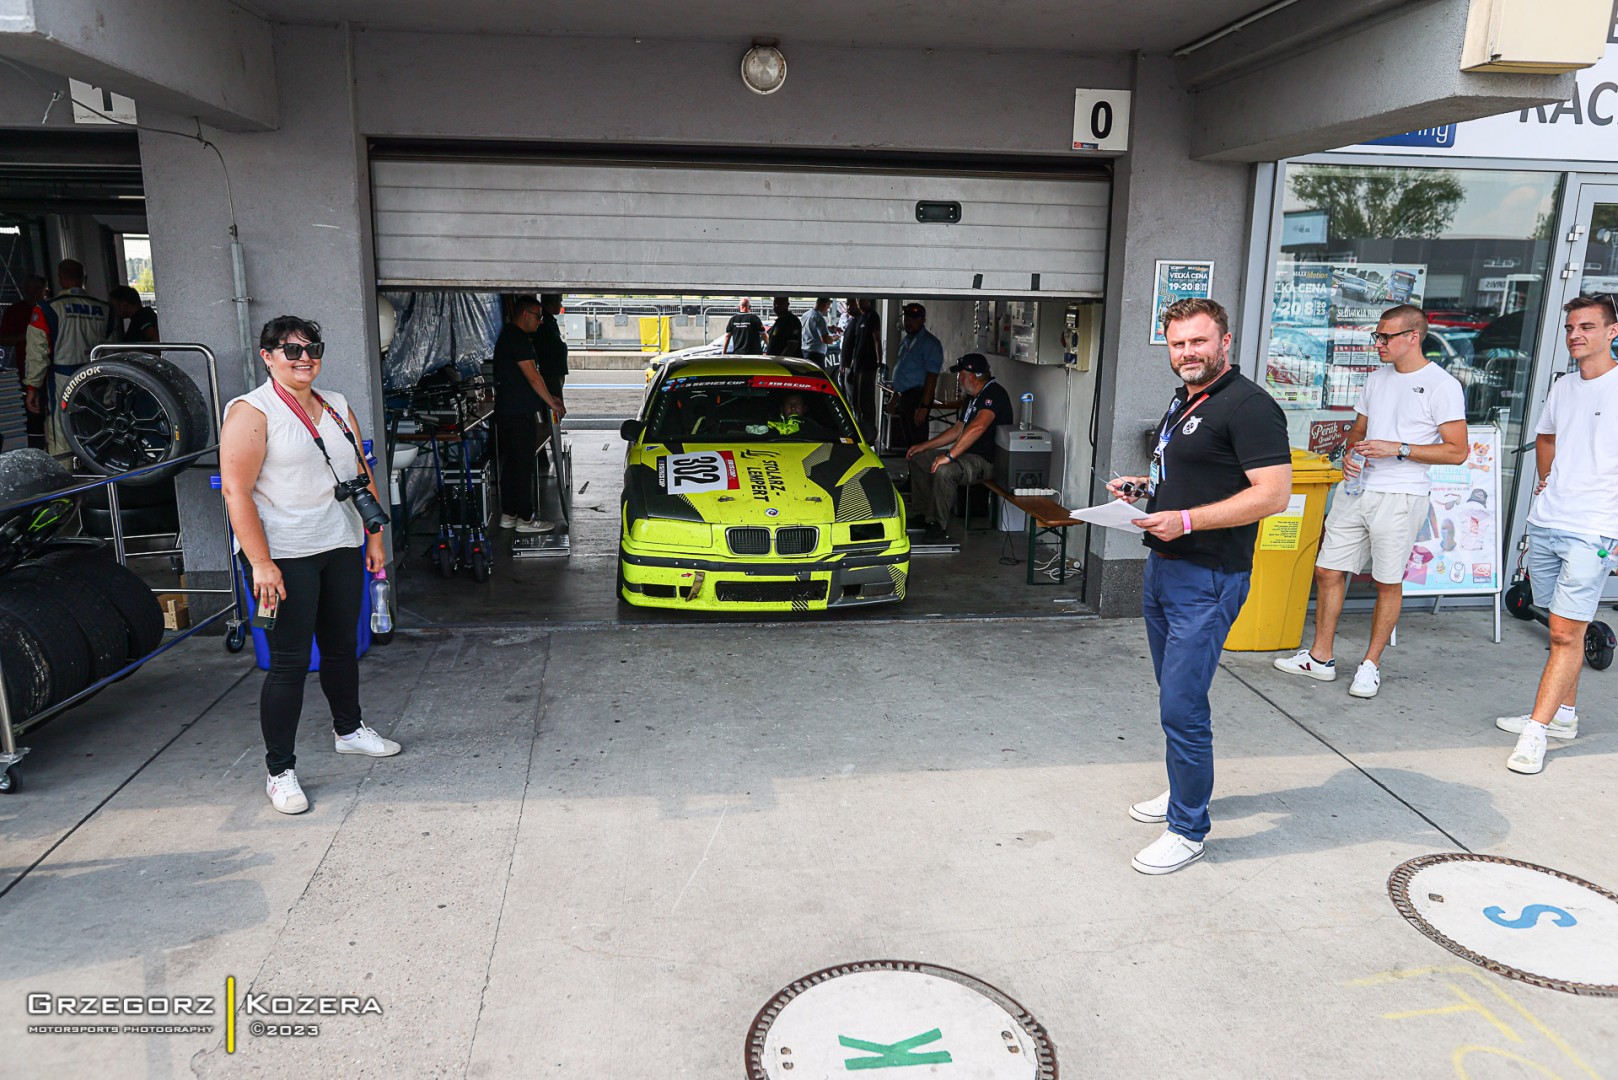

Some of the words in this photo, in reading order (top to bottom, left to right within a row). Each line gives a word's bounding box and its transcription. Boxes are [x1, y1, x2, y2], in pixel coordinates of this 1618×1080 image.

[1091, 101, 1112, 139] 0
[1169, 282, 1193, 291] 19-20
[1194, 283, 1200, 291] 8
[1298, 283, 1328, 294] CENA
[1304, 301, 1314, 316] 8
[1316, 301, 1327, 309] 20
[1316, 308, 1326, 316] 23
[1337, 308, 1367, 318] SLOVAKIA
[1367, 309, 1382, 318] RING
[824, 353, 841, 368] NL
[672, 456, 721, 487] 302
[746, 466, 770, 502] LEMPERT
